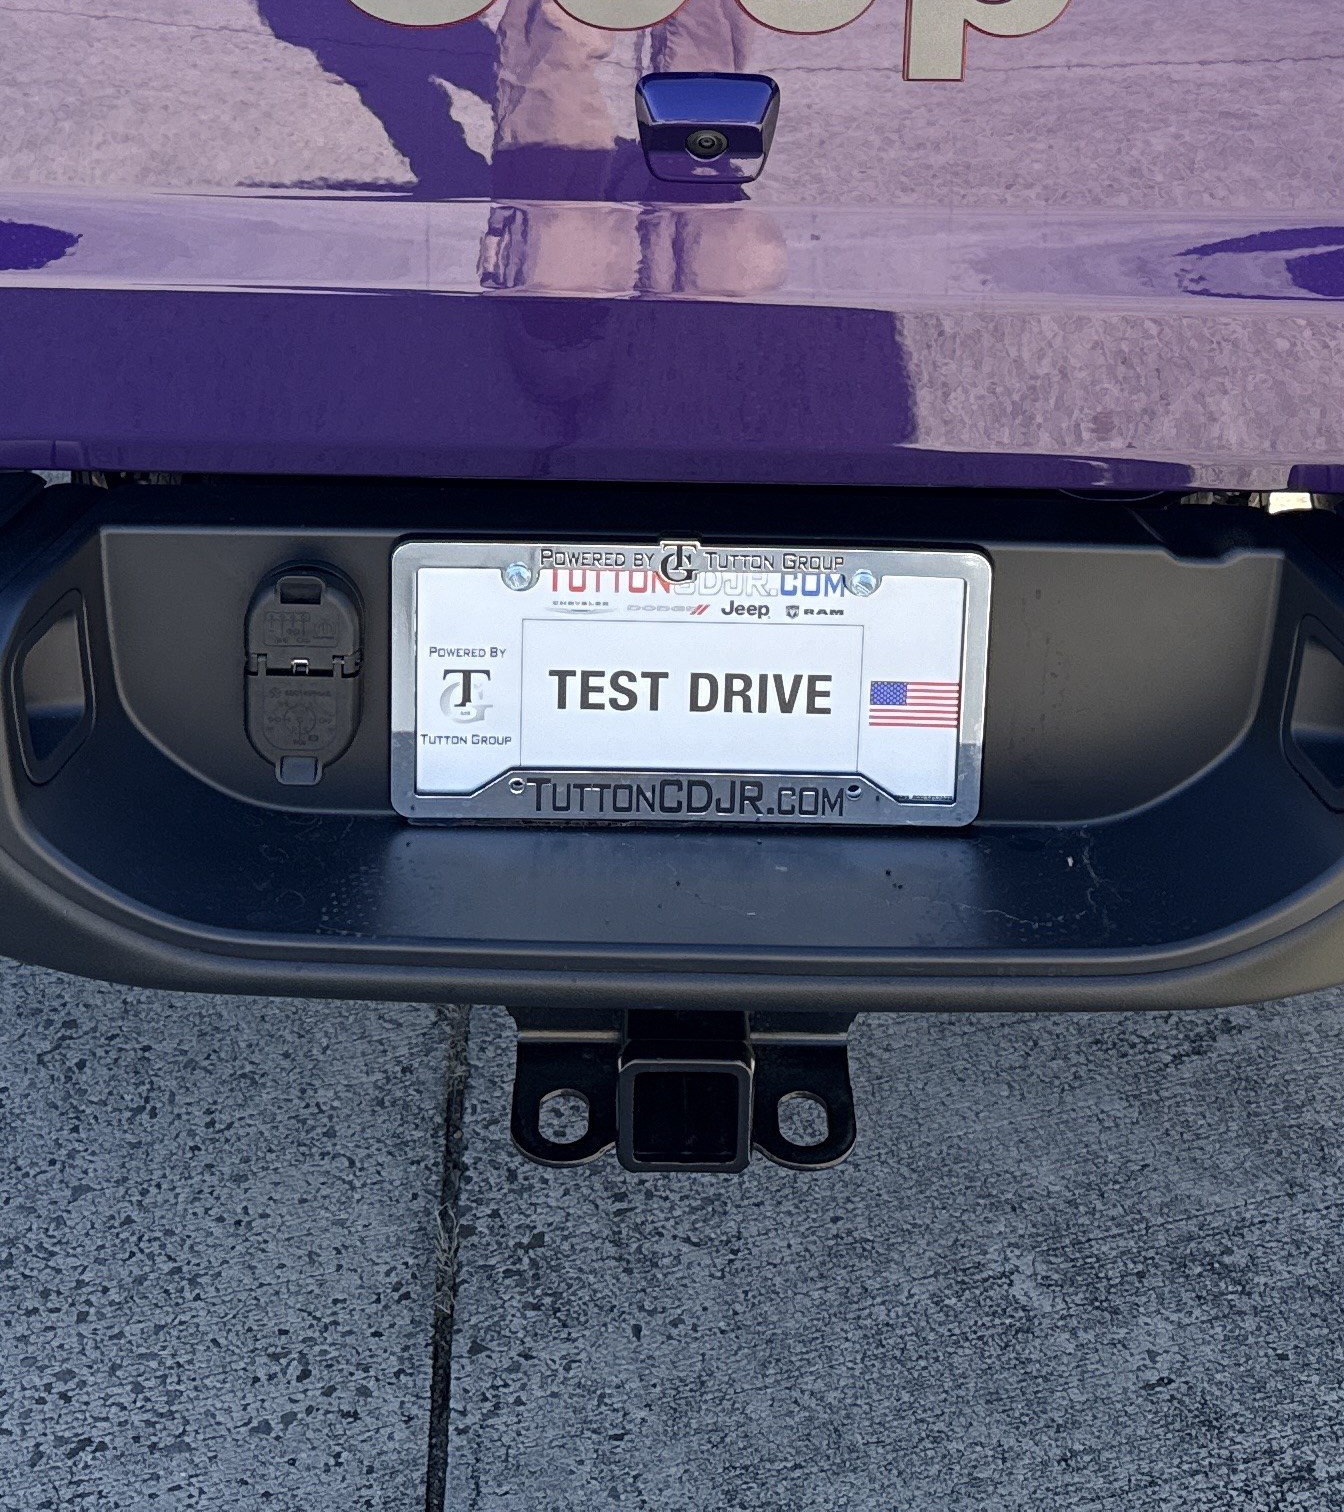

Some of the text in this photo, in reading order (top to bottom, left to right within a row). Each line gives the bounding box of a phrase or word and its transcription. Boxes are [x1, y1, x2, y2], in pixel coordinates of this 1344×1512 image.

[721, 600, 771, 619] Jeep
[803, 608, 844, 616] RAM
[548, 669, 832, 715] TEST DRIVE
